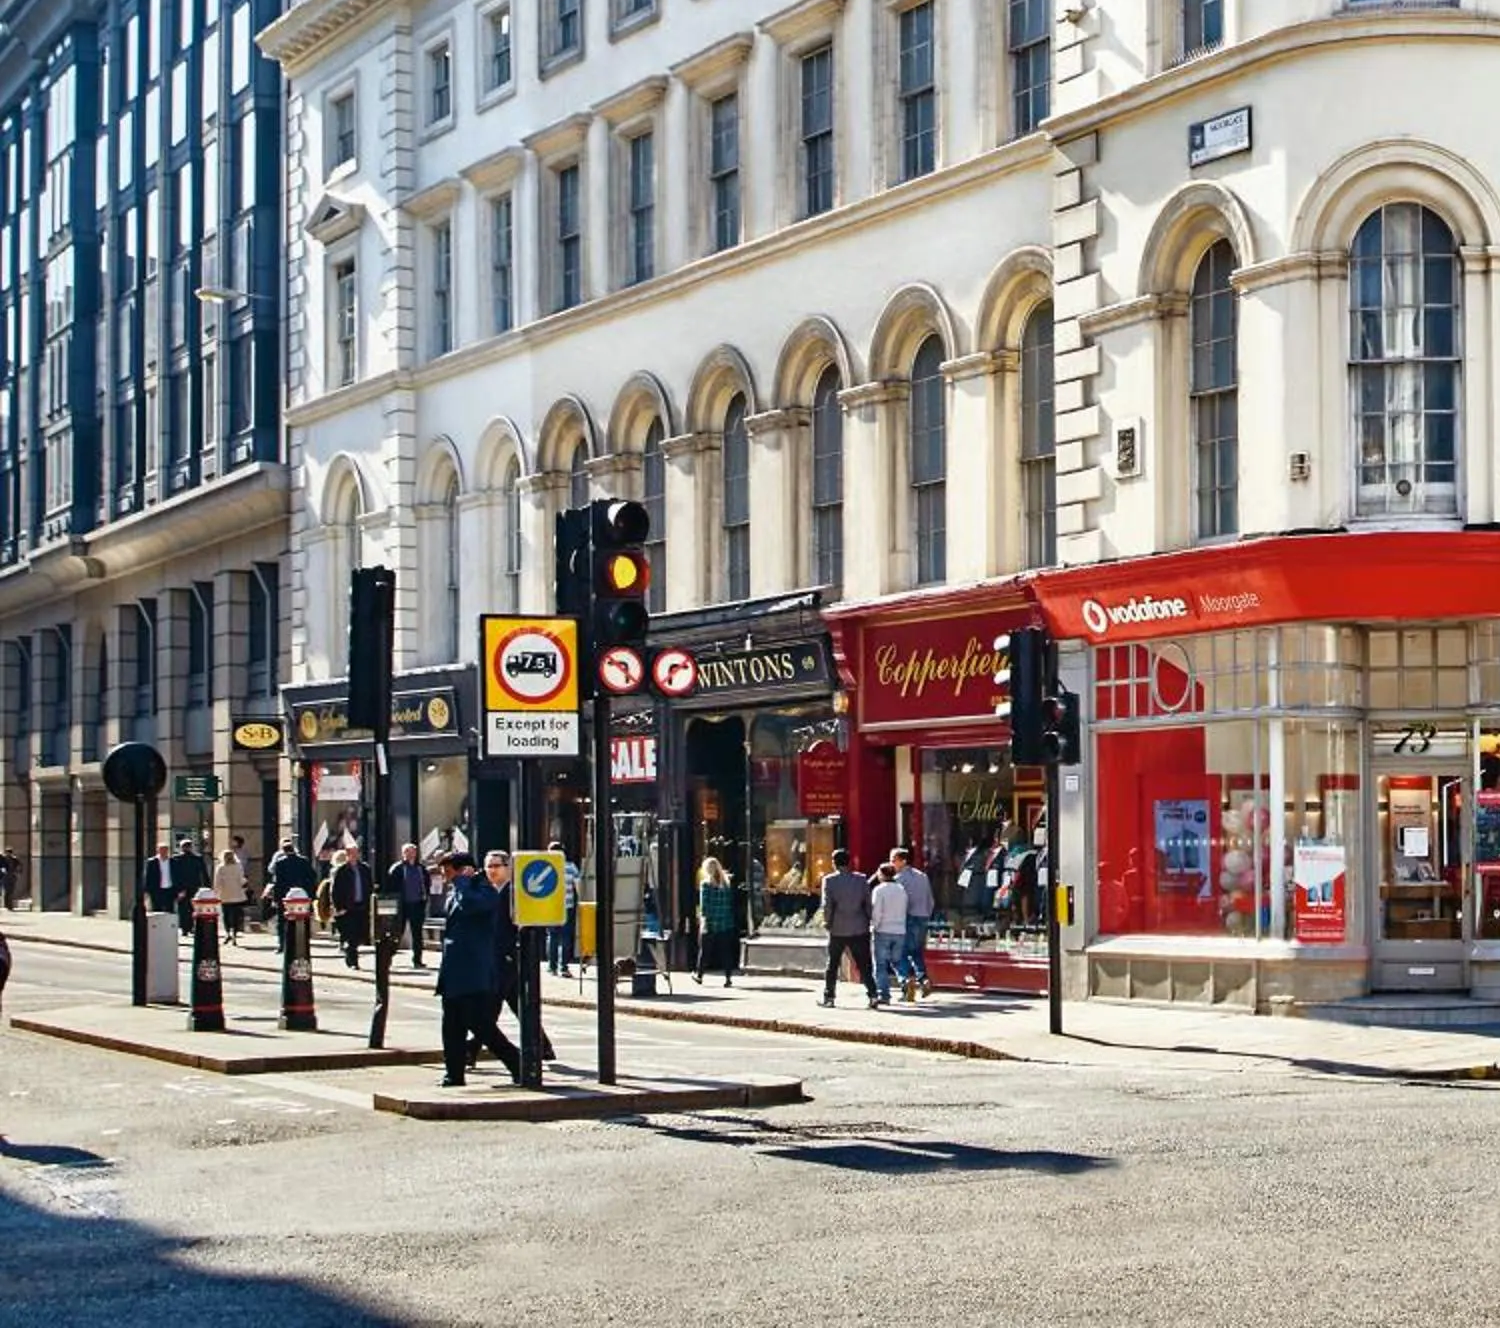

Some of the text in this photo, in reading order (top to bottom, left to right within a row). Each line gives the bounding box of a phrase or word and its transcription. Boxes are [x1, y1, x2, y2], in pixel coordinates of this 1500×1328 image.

[1106, 594, 1188, 625] vodafone
[1199, 591, 1262, 614] Moorgate
[495, 717, 570, 732] Except for
[507, 734, 559, 750] loading
